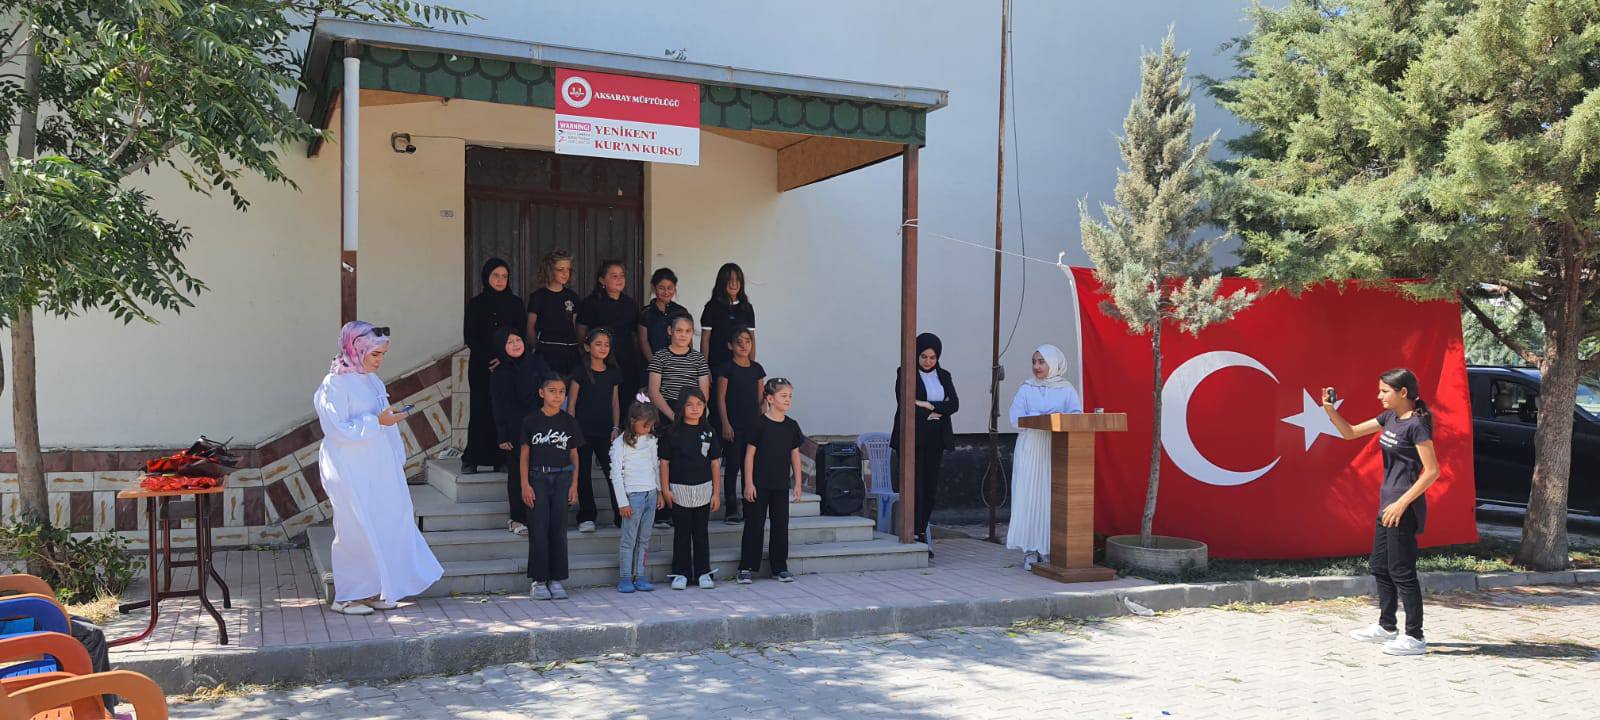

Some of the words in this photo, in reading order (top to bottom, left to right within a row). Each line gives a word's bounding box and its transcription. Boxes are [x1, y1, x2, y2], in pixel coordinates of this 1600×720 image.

[594, 91, 631, 102] AKSARAY
[594, 126, 657, 139] YENİKENT
[594, 140, 640, 153] KUR'AN
[642, 144, 682, 156] KURSU
